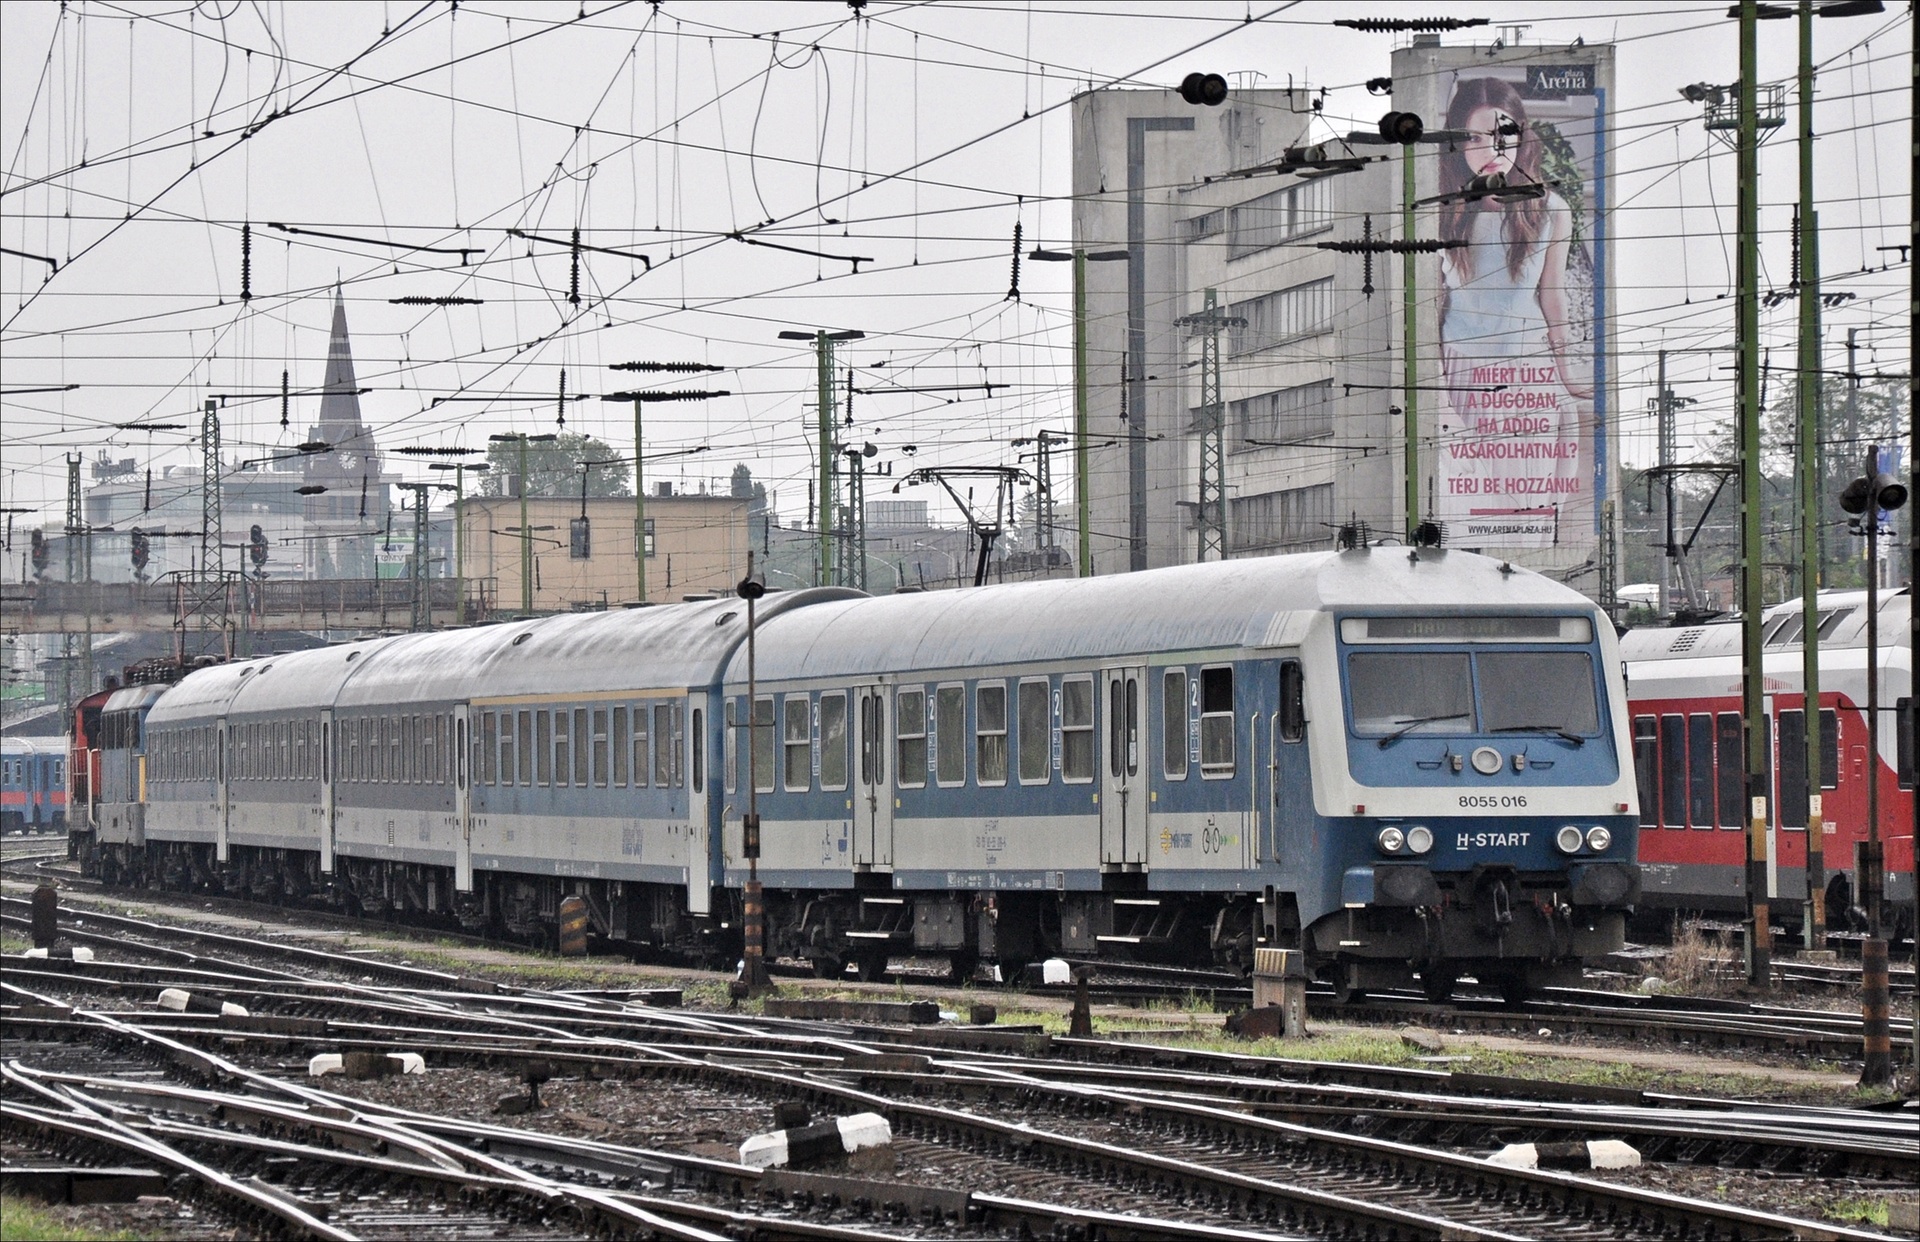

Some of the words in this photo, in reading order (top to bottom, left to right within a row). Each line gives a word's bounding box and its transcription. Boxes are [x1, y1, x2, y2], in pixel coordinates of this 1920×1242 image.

[1533, 71, 1586, 89] Arena
[1473, 363, 1516, 384] MIÉRT
[1521, 363, 1555, 384] ÜLSZ
[1467, 393, 1477, 408] A
[1481, 387, 1559, 411] DUGÓBAN,
[1478, 418, 1498, 433] HA
[1502, 417, 1550, 433] ADDIG
[1449, 437, 1578, 459] VÁSÁROLHATNÁL?
[1448, 473, 1478, 494] TÉRJ
[1483, 478, 1500, 494] BE
[1505, 473, 1579, 494] HOZZÁNK!
[1468, 525, 1552, 535] WWW.ARENAPLAZA.HU
[1054, 693, 1060, 716] 2
[1191, 682, 1198, 707] 2
[813, 706, 819, 727] 2
[928, 699, 935, 720] 2
[1459, 796, 1498, 808] 8055
[1501, 796, 1528, 808] 016
[1456, 833, 1531, 851] H-START
